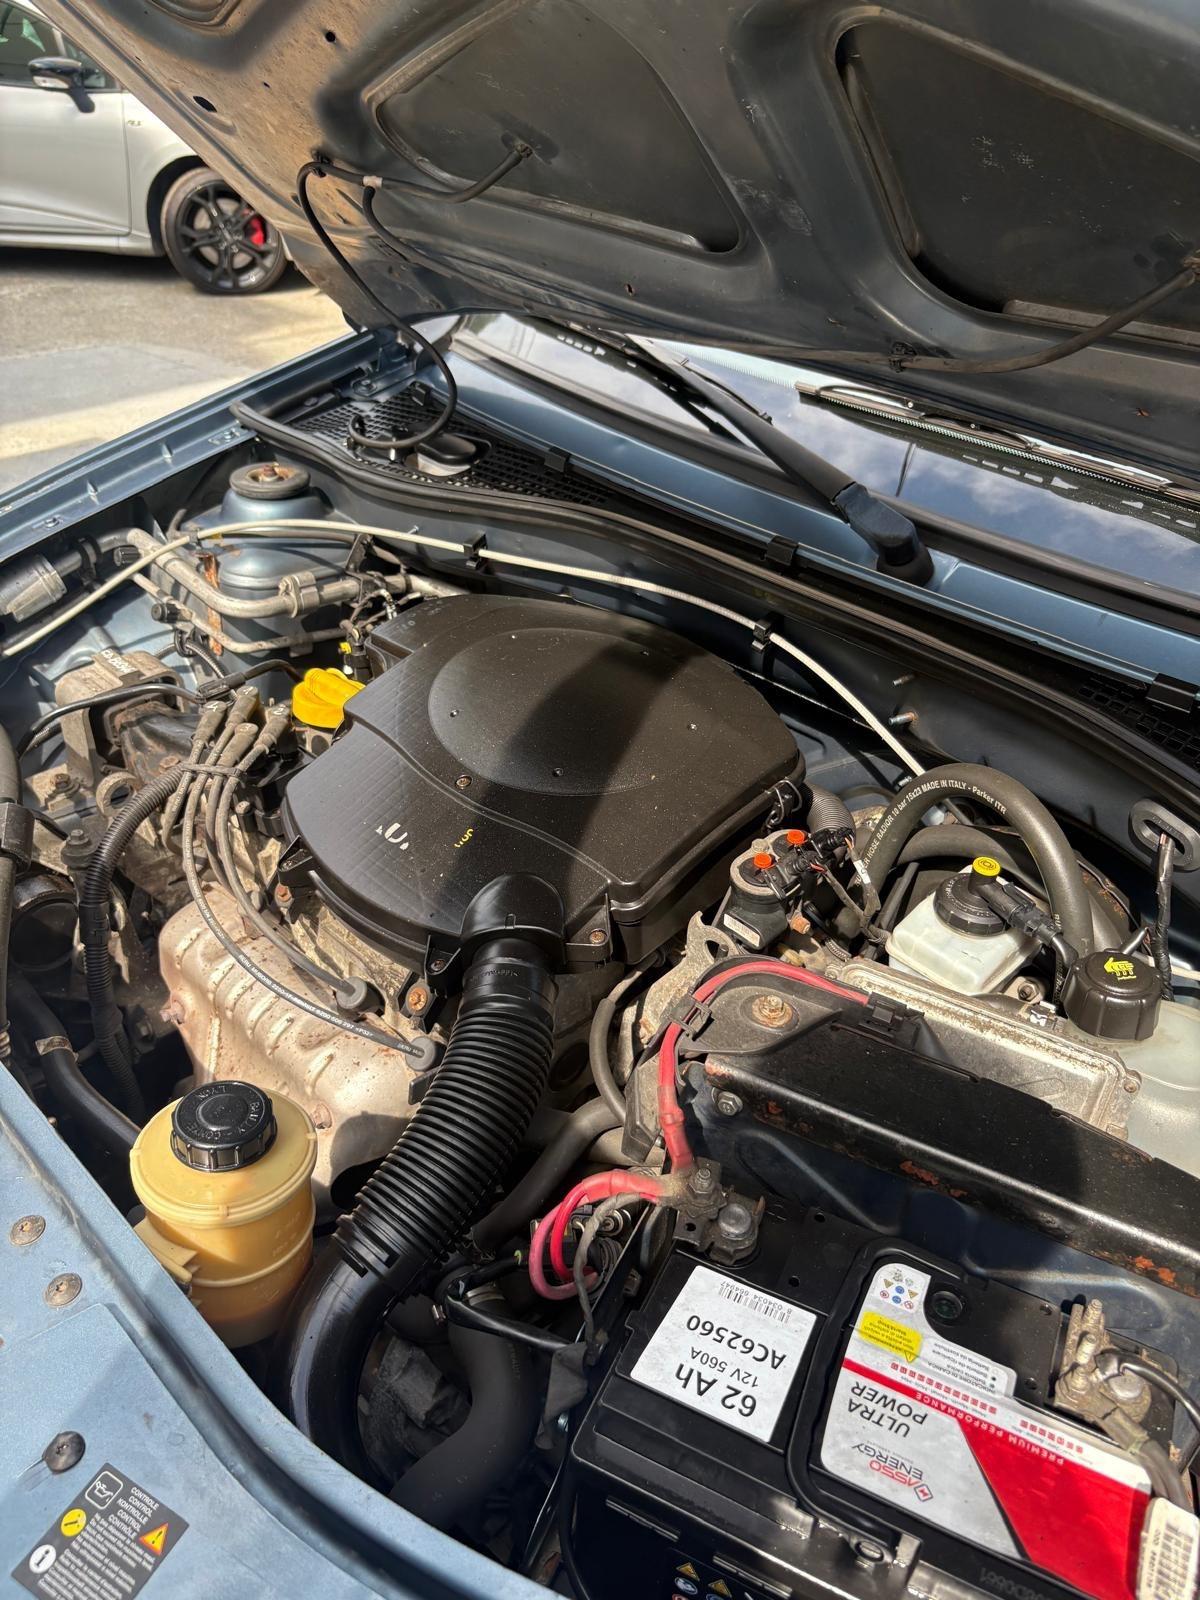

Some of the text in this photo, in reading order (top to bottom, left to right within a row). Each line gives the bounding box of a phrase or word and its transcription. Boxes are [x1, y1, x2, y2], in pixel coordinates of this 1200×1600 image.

[865, 837, 880, 856] HOSE
[874, 814, 895, 840] RADIOR
[920, 780, 940, 794] MADE
[945, 780, 967, 790] ITALY
[970, 785, 995, 804] Parker
[993, 799, 1007, 815] ITR
[719, 1278, 750, 1297] 664947
[751, 1292, 783, 1312] 034034
[684, 1312, 787, 1371] AC62560
[686, 1345, 762, 1389] 12V 560A
[669, 1361, 760, 1420] 62 Ah
[848, 1379, 929, 1425] POWER
[843, 1397, 912, 1438] ULTRA
[913, 1390, 1004, 1437] PERFORMANCE
[850, 1439, 924, 1480] ENERGY
[1006, 1433, 1065, 1465] PREMIUM
[866, 1458, 920, 1490] ASSO
[116, 1496, 149, 1524] KONTROLLE
[127, 1494, 154, 1517] CONTROL
[129, 1485, 159, 1511] CONTROLE
[115, 1508, 143, 1532] CONTROL
